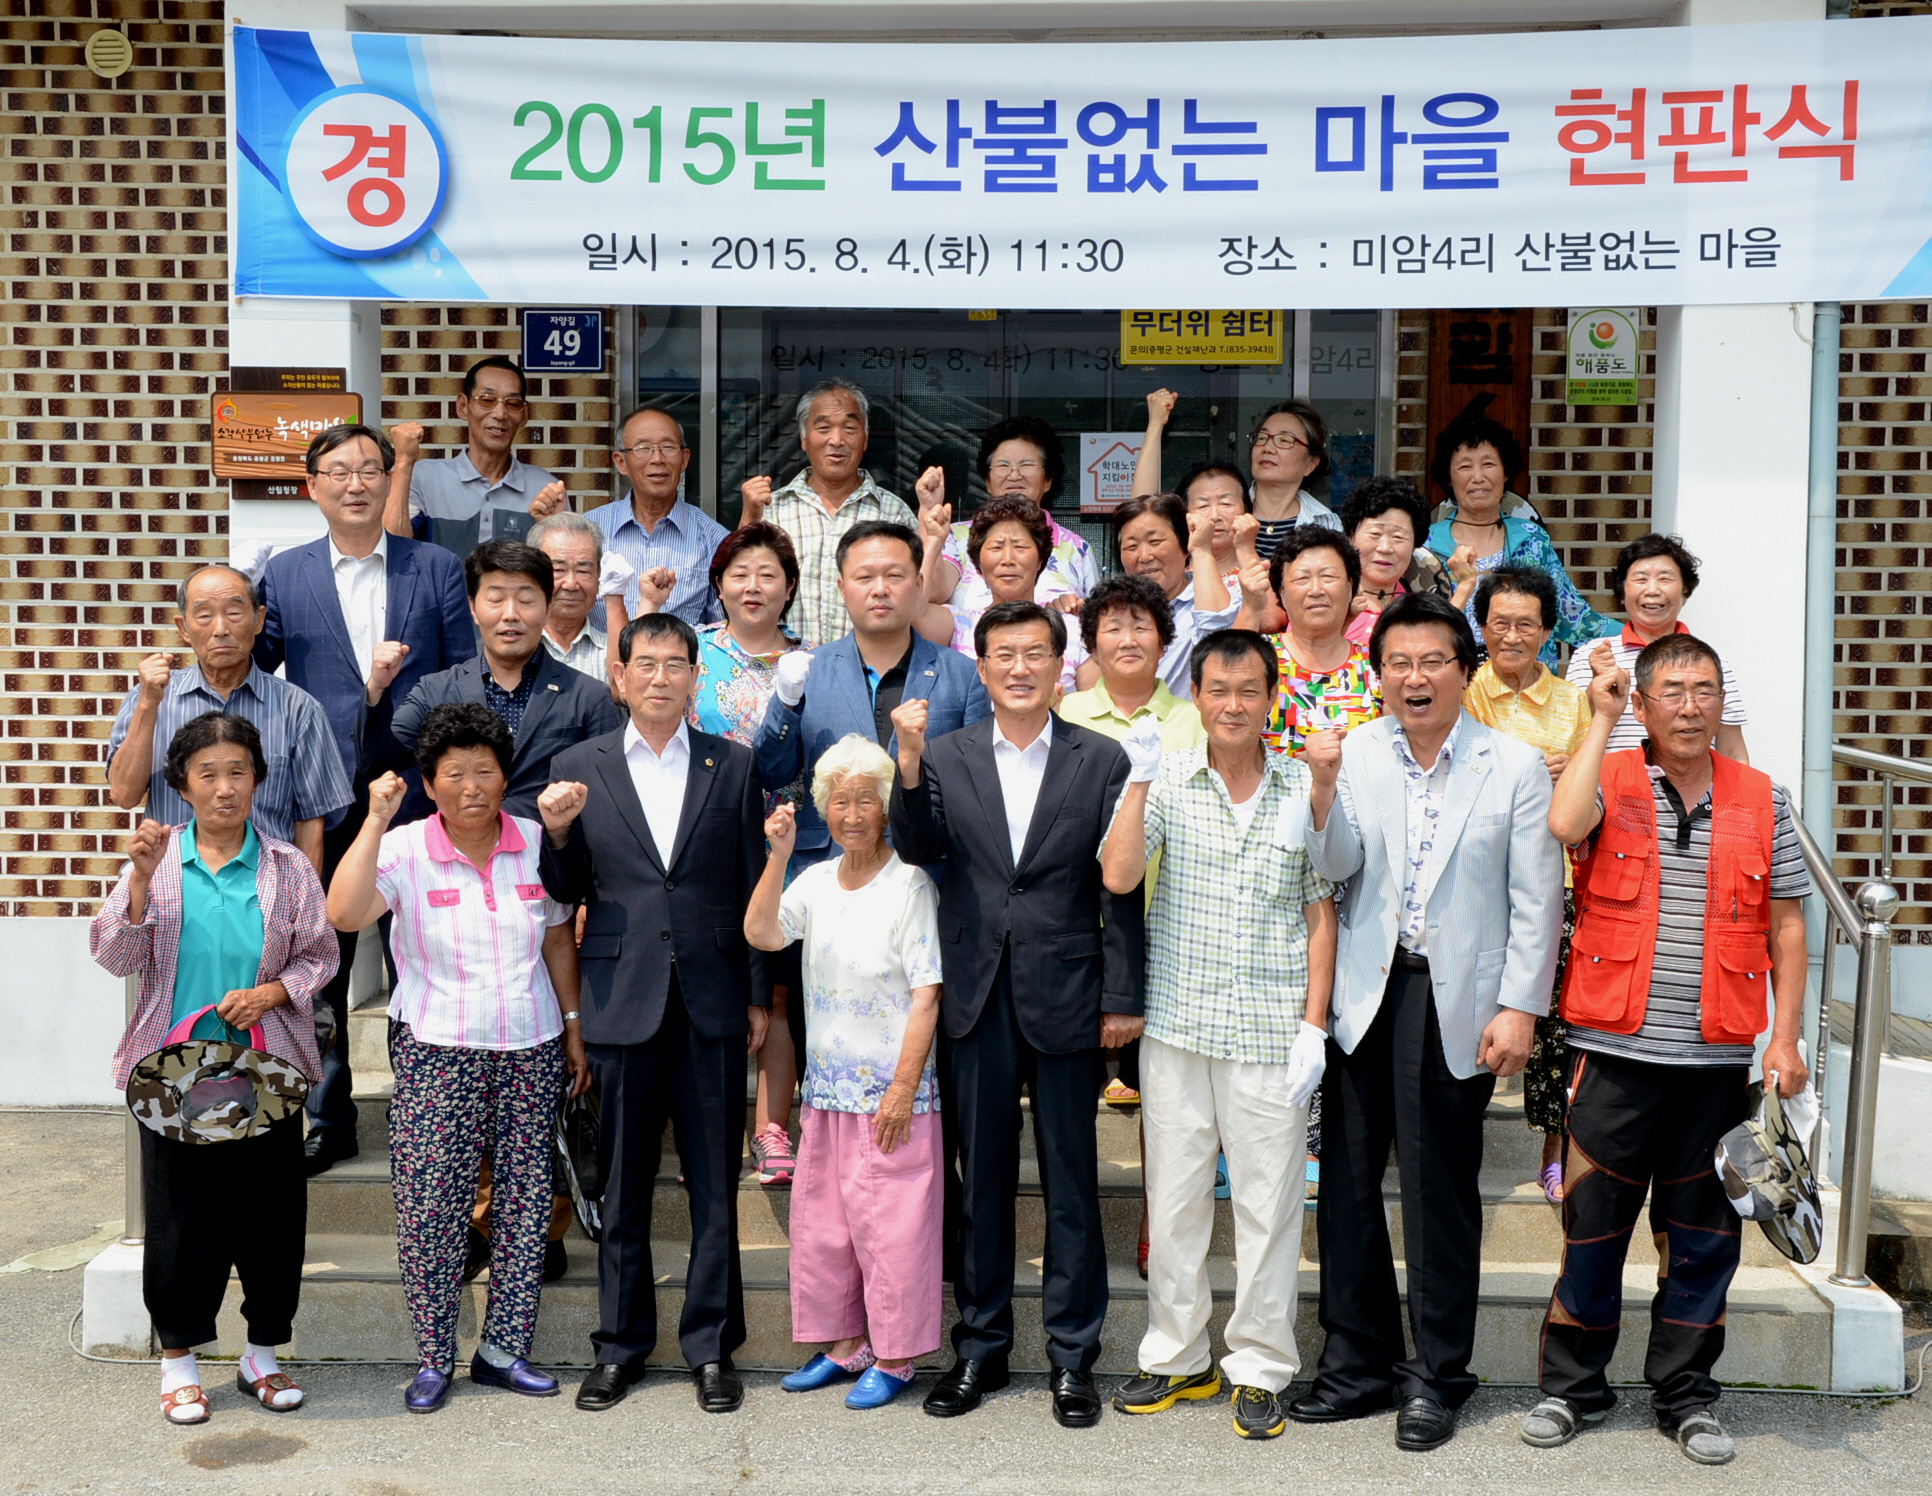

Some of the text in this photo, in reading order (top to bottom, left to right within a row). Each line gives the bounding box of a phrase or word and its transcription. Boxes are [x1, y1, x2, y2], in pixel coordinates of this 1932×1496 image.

[510, 80, 1860, 194] 2015년 산불없는 마을 현판식
[321, 123, 407, 228] 경
[582, 232, 657, 271] 일시
[711, 236, 817, 274] 2015.
[834, 237, 869, 274] 8.
[886, 233, 990, 276] 4.(화)
[1010, 238, 1125, 273] 11:30
[1218, 235, 1298, 276] 장소
[1353, 233, 1494, 274] 미암4리
[1514, 230, 1681, 272] 산불없는
[1700, 227, 1782, 269] 마을
[549, 315, 576, 327] 자양길
[1130, 310, 1274, 337] 무더위 쉼터
[543, 329, 581, 356] 49
[1575, 358, 1627, 374] 해품도
